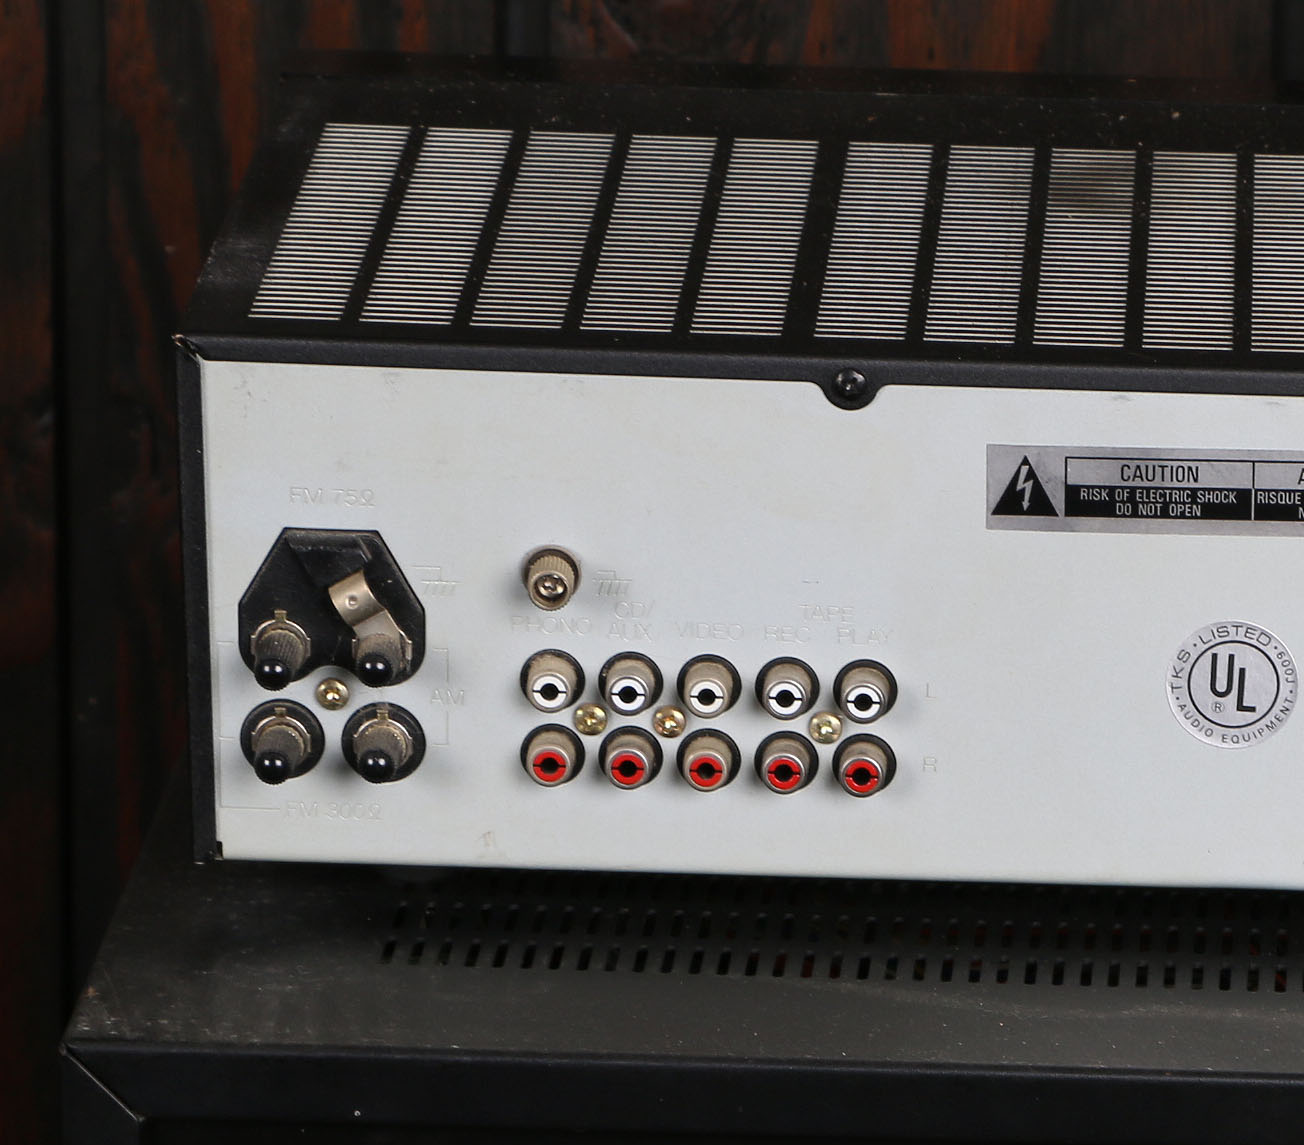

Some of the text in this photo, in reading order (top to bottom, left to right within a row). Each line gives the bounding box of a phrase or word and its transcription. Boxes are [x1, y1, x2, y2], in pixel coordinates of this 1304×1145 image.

[1120, 464, 1200, 484] CAUTION
[1080, 489, 1237, 504] RISK OF ELECTRIC SHOCK
[1256, 492, 1302, 507] RISQUE
[1116, 503, 1201, 518] DO NOT OPEN
[511, 616, 592, 638] PHONO
[608, 621, 650, 641] AUX
[678, 621, 742, 641] VIDEO
[764, 625, 810, 644] REC
[838, 627, 891, 647] PLAY
[1199, 625, 1272, 647] LISTED
[1210, 653, 1257, 713] UL
[1178, 698, 1295, 744] AUDIO EQUIPMENT
